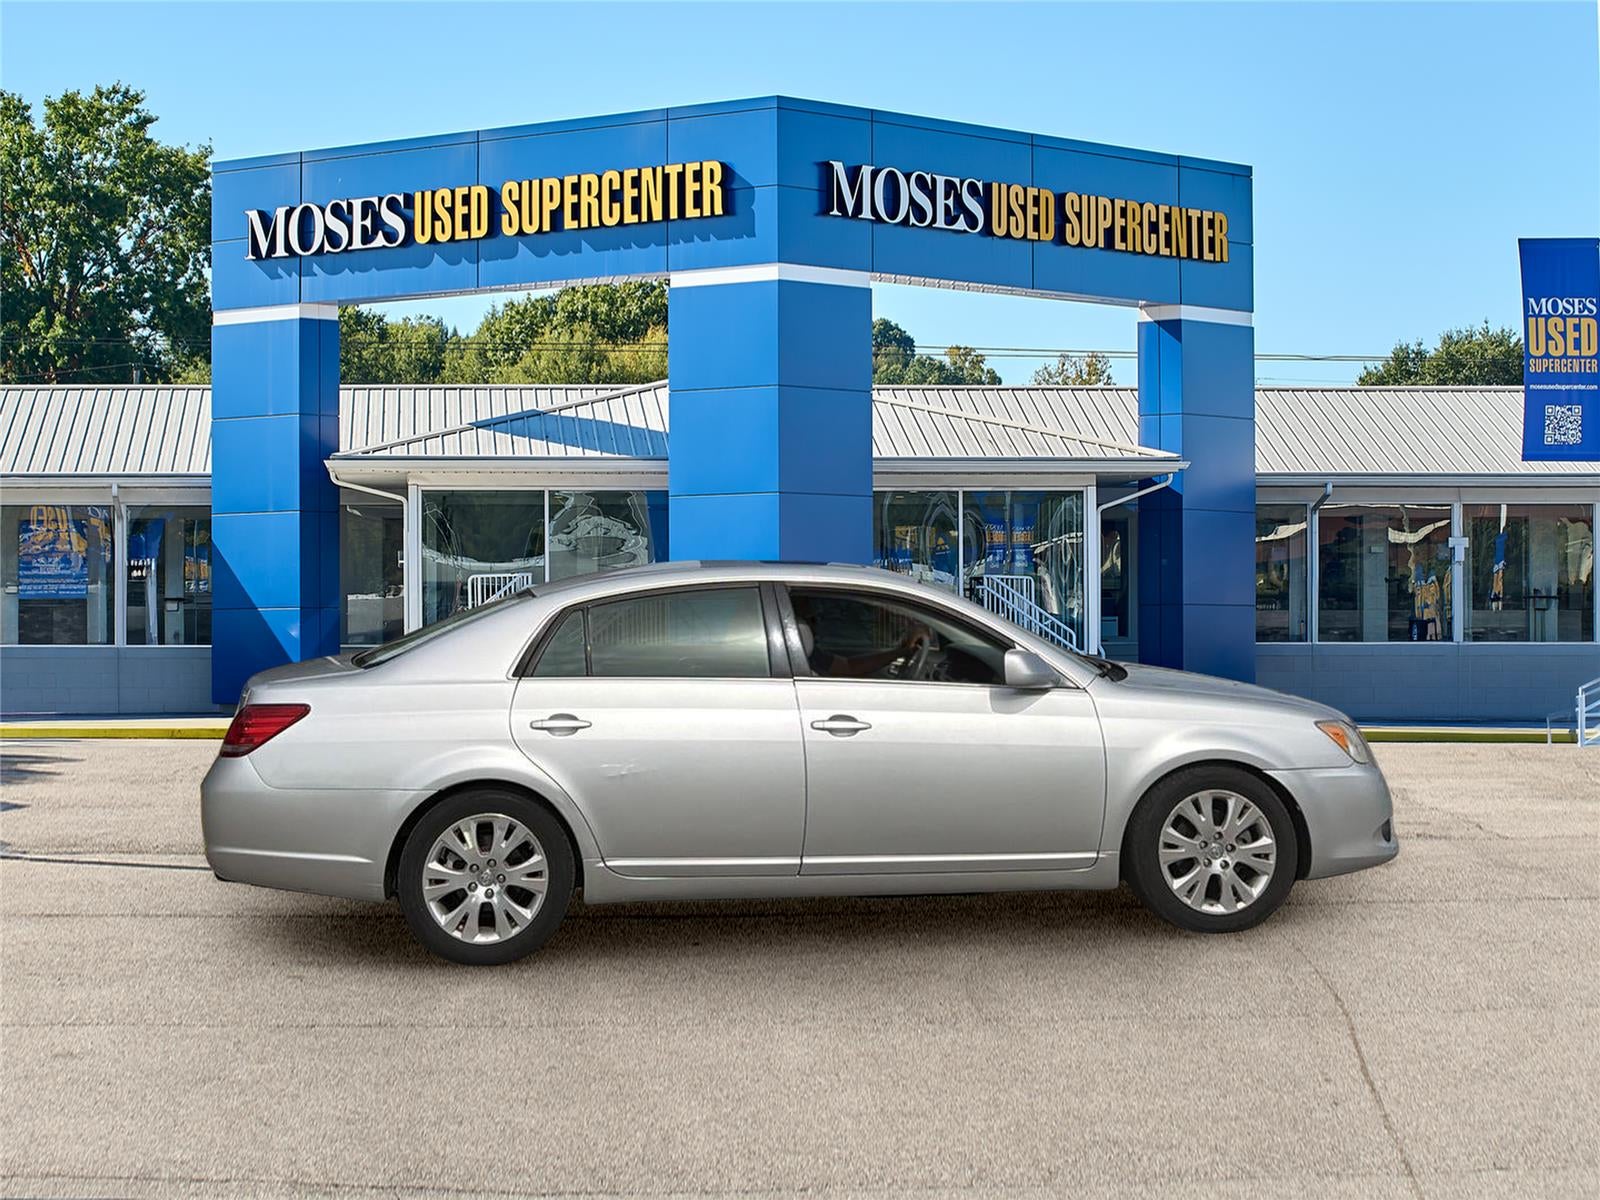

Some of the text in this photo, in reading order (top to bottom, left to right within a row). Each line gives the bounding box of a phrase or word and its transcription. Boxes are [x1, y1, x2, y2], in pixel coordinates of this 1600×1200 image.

[245, 160, 724, 261] MOSES USED SUPERCENTER
[829, 160, 1230, 263] MOSES USED SUPERCENTER
[1528, 297, 1597, 316] MOSES
[1528, 316, 1598, 357] USED
[1529, 358, 1598, 374] SUPERCENTER
